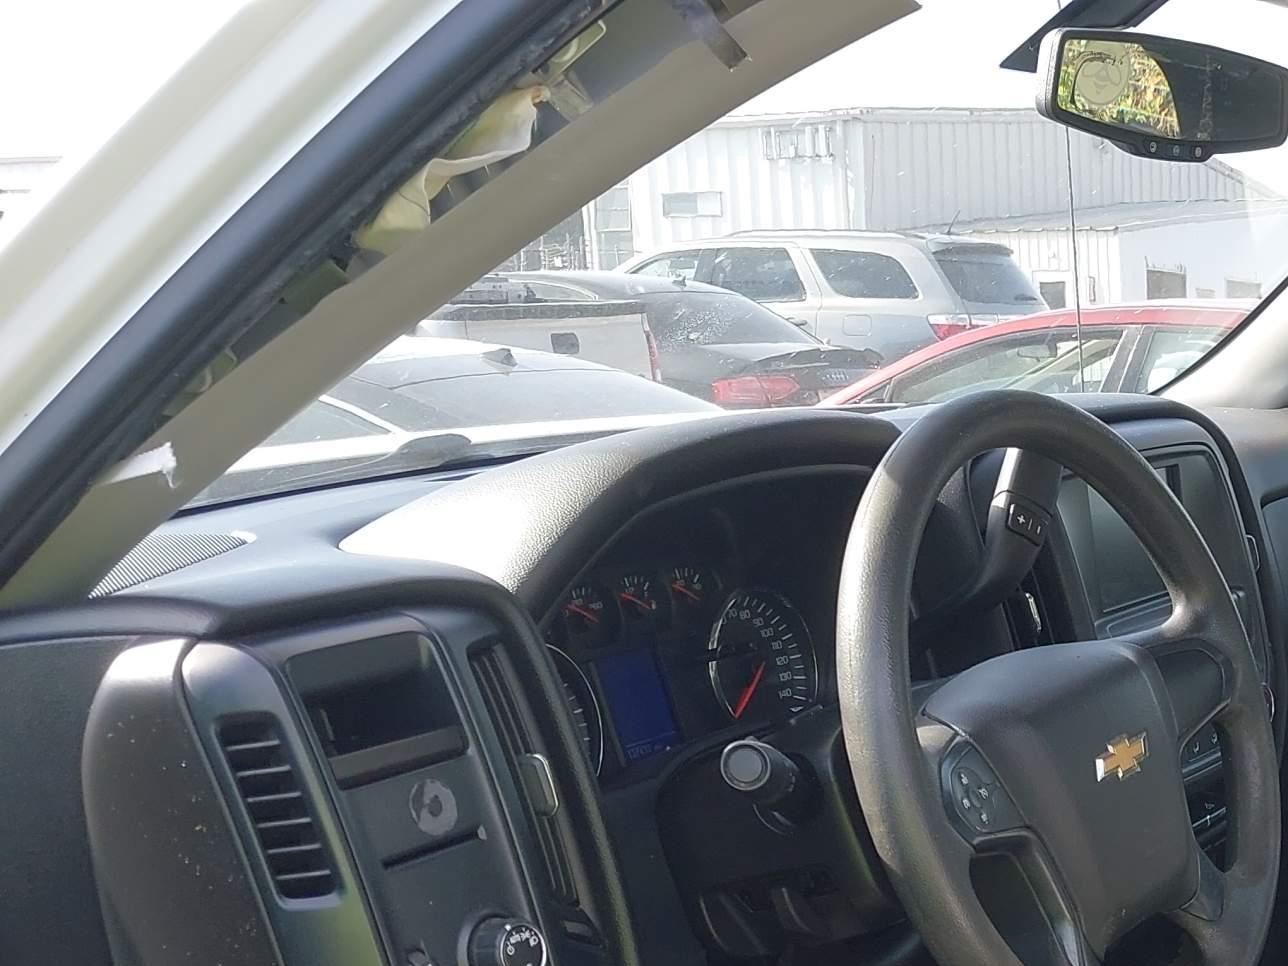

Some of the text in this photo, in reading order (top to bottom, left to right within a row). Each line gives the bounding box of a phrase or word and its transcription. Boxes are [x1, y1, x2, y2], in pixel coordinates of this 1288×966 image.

[760, 627, 774, 638] 100
[771, 640, 783, 650] 110
[776, 655, 789, 666] 120
[779, 671, 792, 681] 130
[778, 688, 792, 699] 140
